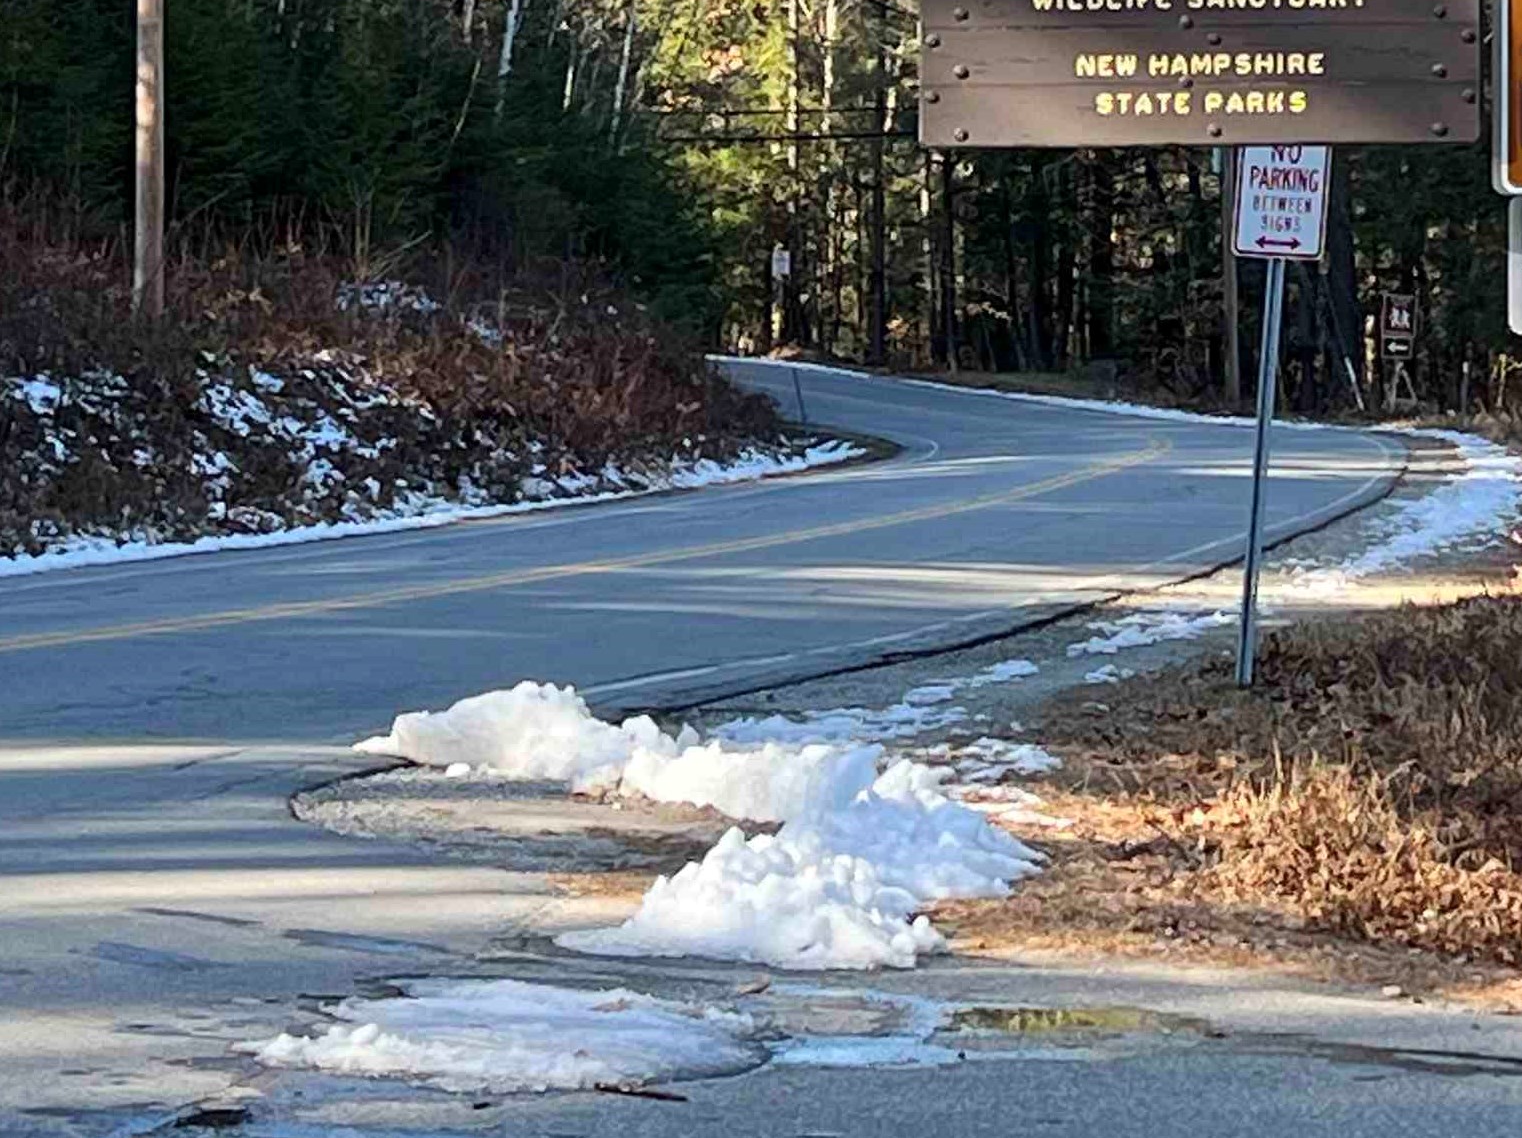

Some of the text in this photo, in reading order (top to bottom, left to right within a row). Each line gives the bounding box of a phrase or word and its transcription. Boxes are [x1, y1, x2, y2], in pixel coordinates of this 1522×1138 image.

[1075, 52, 1325, 78] NEW HAMPSHIRE
[1094, 90, 1308, 115] STATE PARKS
[1250, 165, 1319, 193] PARKING
[1252, 194, 1312, 213] BETWEEN
